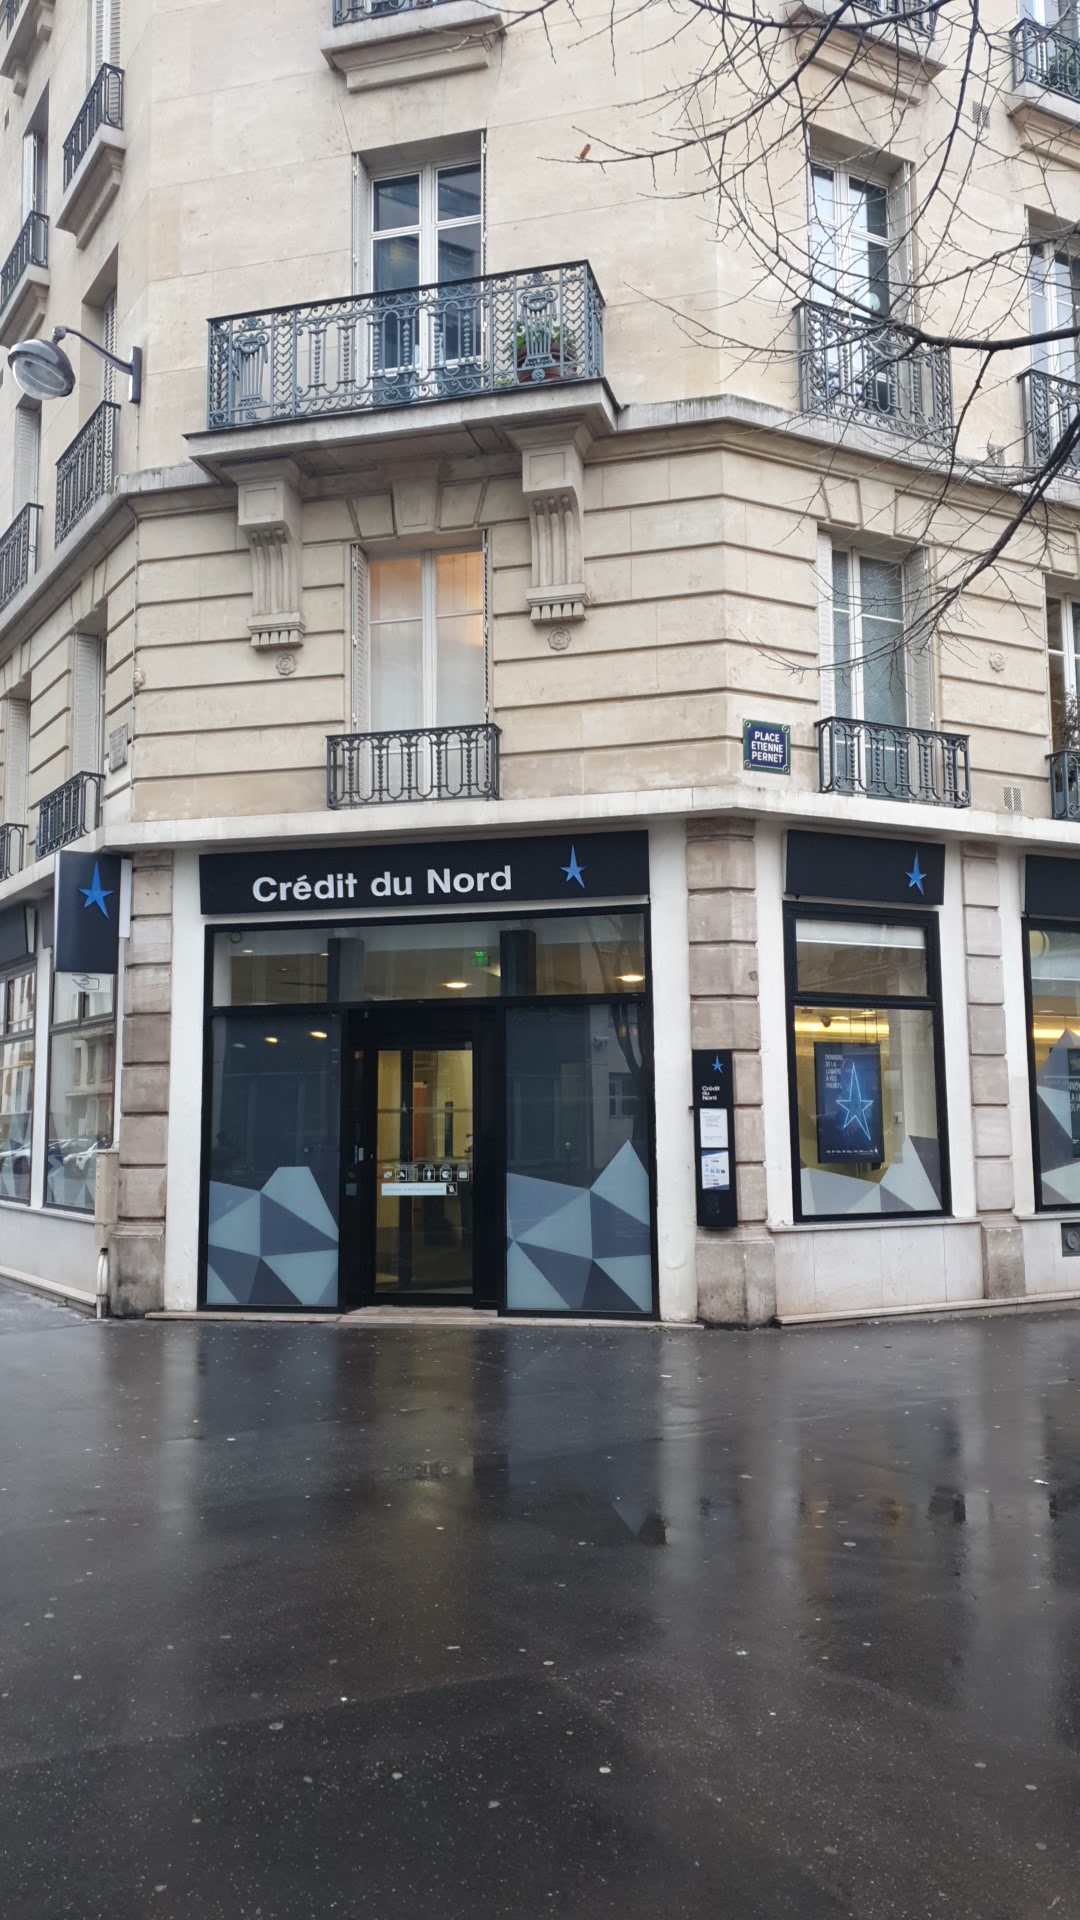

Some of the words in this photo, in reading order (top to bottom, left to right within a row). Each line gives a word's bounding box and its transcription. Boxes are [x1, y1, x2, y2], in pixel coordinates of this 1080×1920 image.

[754, 731, 779, 743] PLACE
[751, 741, 783, 753] ETIENNE
[752, 751, 783, 764] PERNET
[252, 873, 358, 902] Crédit
[370, 871, 413, 897] du
[427, 865, 512, 894] Nord
